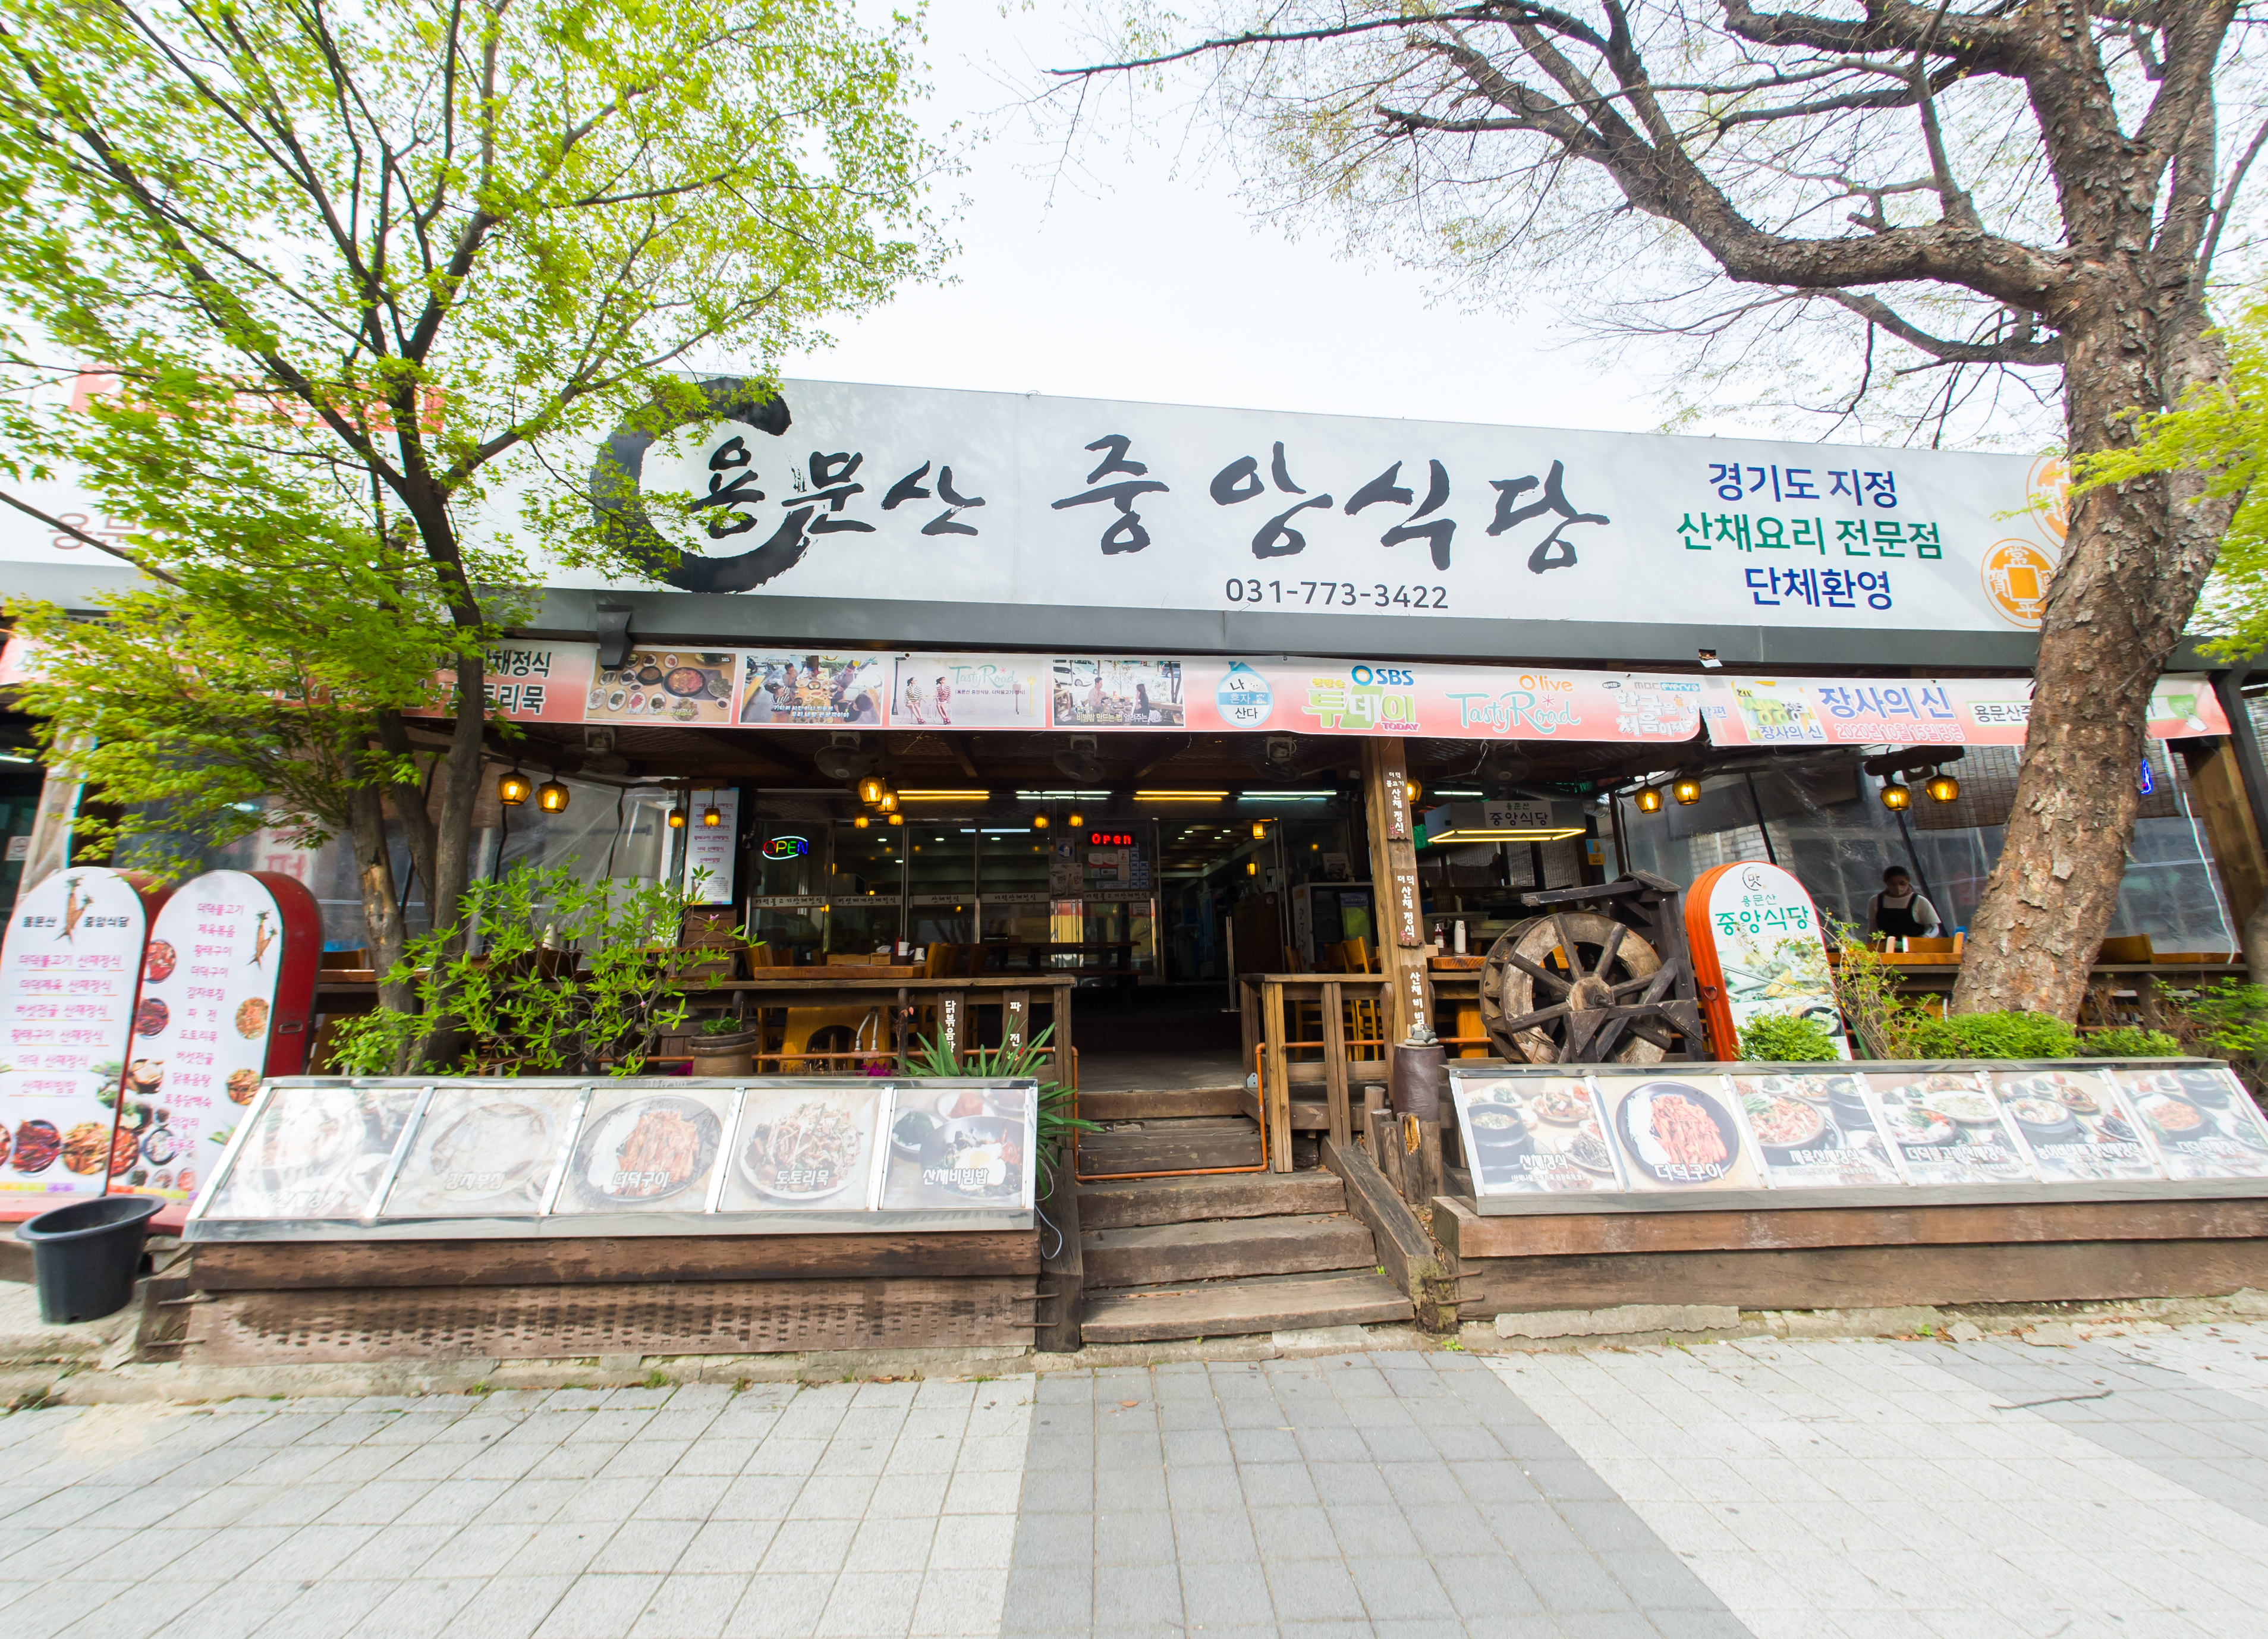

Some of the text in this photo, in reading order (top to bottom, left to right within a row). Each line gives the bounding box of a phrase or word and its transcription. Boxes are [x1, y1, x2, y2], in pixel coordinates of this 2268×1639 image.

[1709, 463, 1897, 509] 경기도 지정
[691, 434, 1610, 574] 용문산 중앙식당
[1676, 512, 1942, 559] 산채요리 전문점
[1225, 578, 1448, 610] 031-773-3422
[1745, 567, 1893, 611] 단체환영
[1229, 678, 1244, 691] 나
[1376, 668, 1414, 686] SBS
[1519, 674, 1574, 692] O'live
[1229, 693, 1251, 704] 혼자
[1612, 689, 1677, 716] 한국은
[1818, 687, 1955, 719] 장사의 신
[1235, 707, 1258, 719] 산다
[1303, 690, 1415, 727] 투데이
[1077, 713, 1095, 722] 비빔밥
[1096, 713, 1115, 722] 만드는
[1116, 713, 1122, 722] 법
[1124, 713, 1148, 722] 알려주는
[1616, 712, 1694, 737] 처음이지?
[1382, 722, 1419, 731] TODAY
[1760, 725, 1823, 740] 장사의 신
[1489, 812, 1548, 826] 중앙식당
[763, 841, 809, 855] OPEN
[1397, 875, 1415, 886] 더덕
[1747, 873, 1762, 888] 맛
[1741, 894, 1777, 907] 용문산
[197, 903, 244, 916] 더덕불고기
[23, 916, 130, 927] 용문산 중앙식당
[1715, 905, 1809, 936] 중앙식당
[194, 945, 232, 957] 황태구이
[191, 965, 229, 979] 더덕구이
[187, 987, 225, 1001] 감자부침
[180, 1030, 218, 1043] 도토리묵
[177, 1051, 214, 1065] 버섯전골
[1520, 1153, 1569, 1170] 산채정식
[612, 1171, 671, 1188] 더덕구이
[775, 1169, 830, 1186] 도토리묵
[922, 1168, 989, 1185] 산채비빔밥
[1654, 1163, 1725, 1181] 더덕구이
